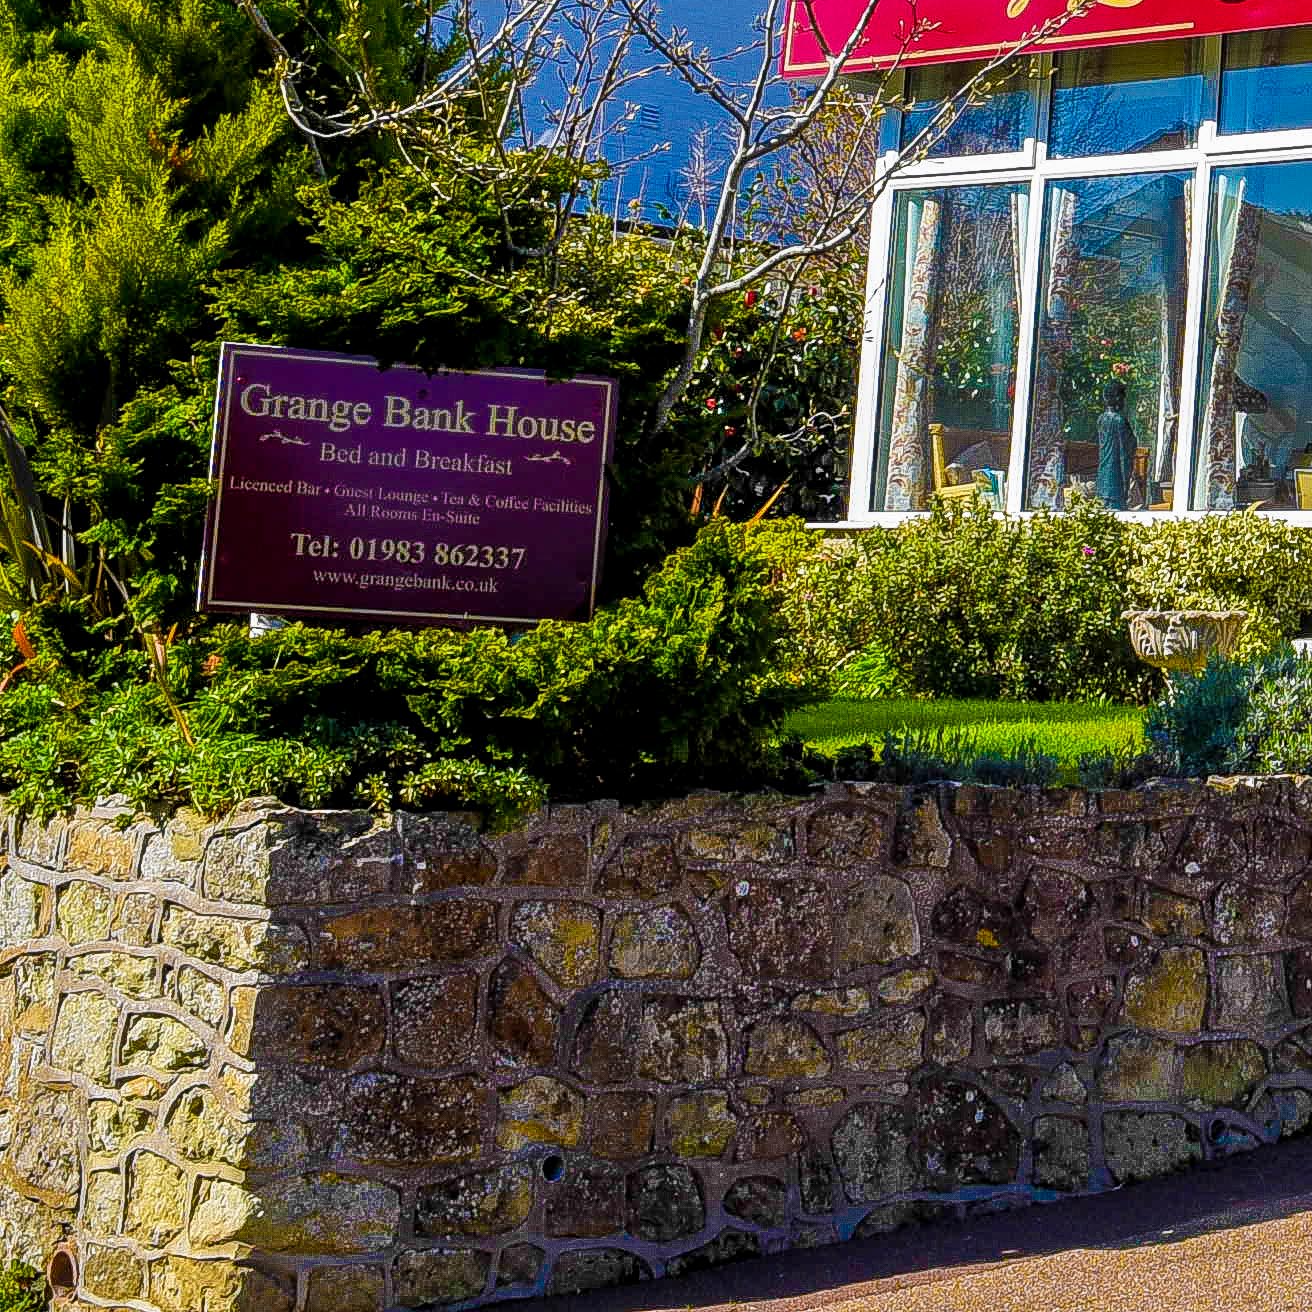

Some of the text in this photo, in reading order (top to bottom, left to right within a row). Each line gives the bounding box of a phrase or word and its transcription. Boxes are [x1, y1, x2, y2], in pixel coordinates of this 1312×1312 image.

[240, 383, 596, 443] Grange Bank House
[320, 442, 513, 475] Bed and Breakfast
[230, 476, 593, 515] Licenced Bar Guest Lounge Tea & Coffee Facilities
[343, 503, 480, 525] All Rooms En-Suite
[291, 532, 528, 570] Tel: 01983 862337
[313, 568, 499, 594] www.grangebank.co.uk
